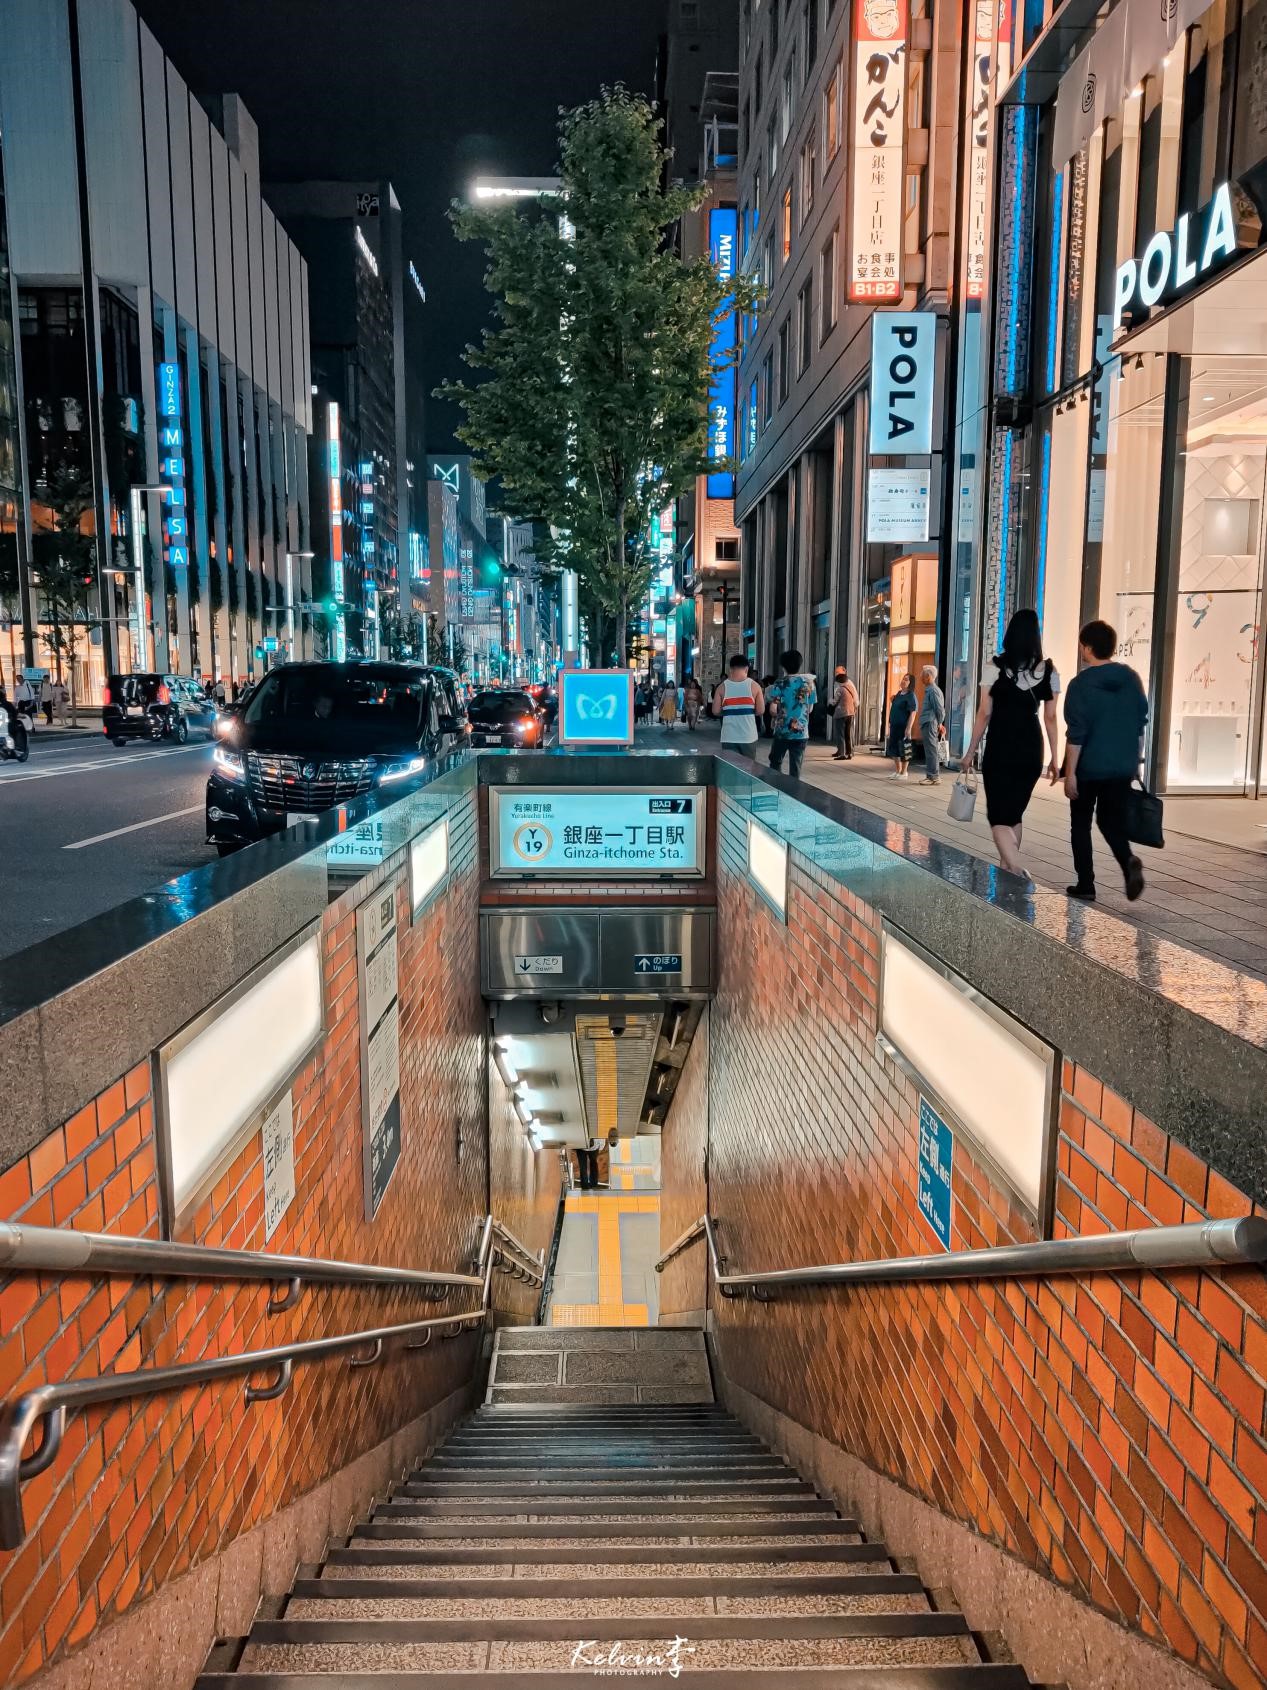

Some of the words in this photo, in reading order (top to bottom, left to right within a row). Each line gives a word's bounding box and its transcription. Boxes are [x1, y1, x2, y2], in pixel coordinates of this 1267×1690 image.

[862, 42, 906, 147] がんこ
[868, 154, 889, 246] 銀座一丁目店
[857, 252, 896, 266] お食事
[1114, 181, 1237, 331] POLA
[857, 266, 896, 280] 宴会処
[888, 326, 918, 441] POLA
[166, 430, 185, 564] MELSA
[513, 803, 552, 813] 有楽町線
[677, 800, 685, 813] 7
[528, 829, 538, 839] Y
[563, 825, 685, 845] 銀座一丁目駅
[526, 841, 543, 853] 19
[564, 846, 655, 859] Ginza-itchome
[660, 846, 683, 859] Sta.
[534, 957, 558, 967] くだり
[920, 1181, 934, 1219] Left
[266, 1197, 281, 1231] Left
